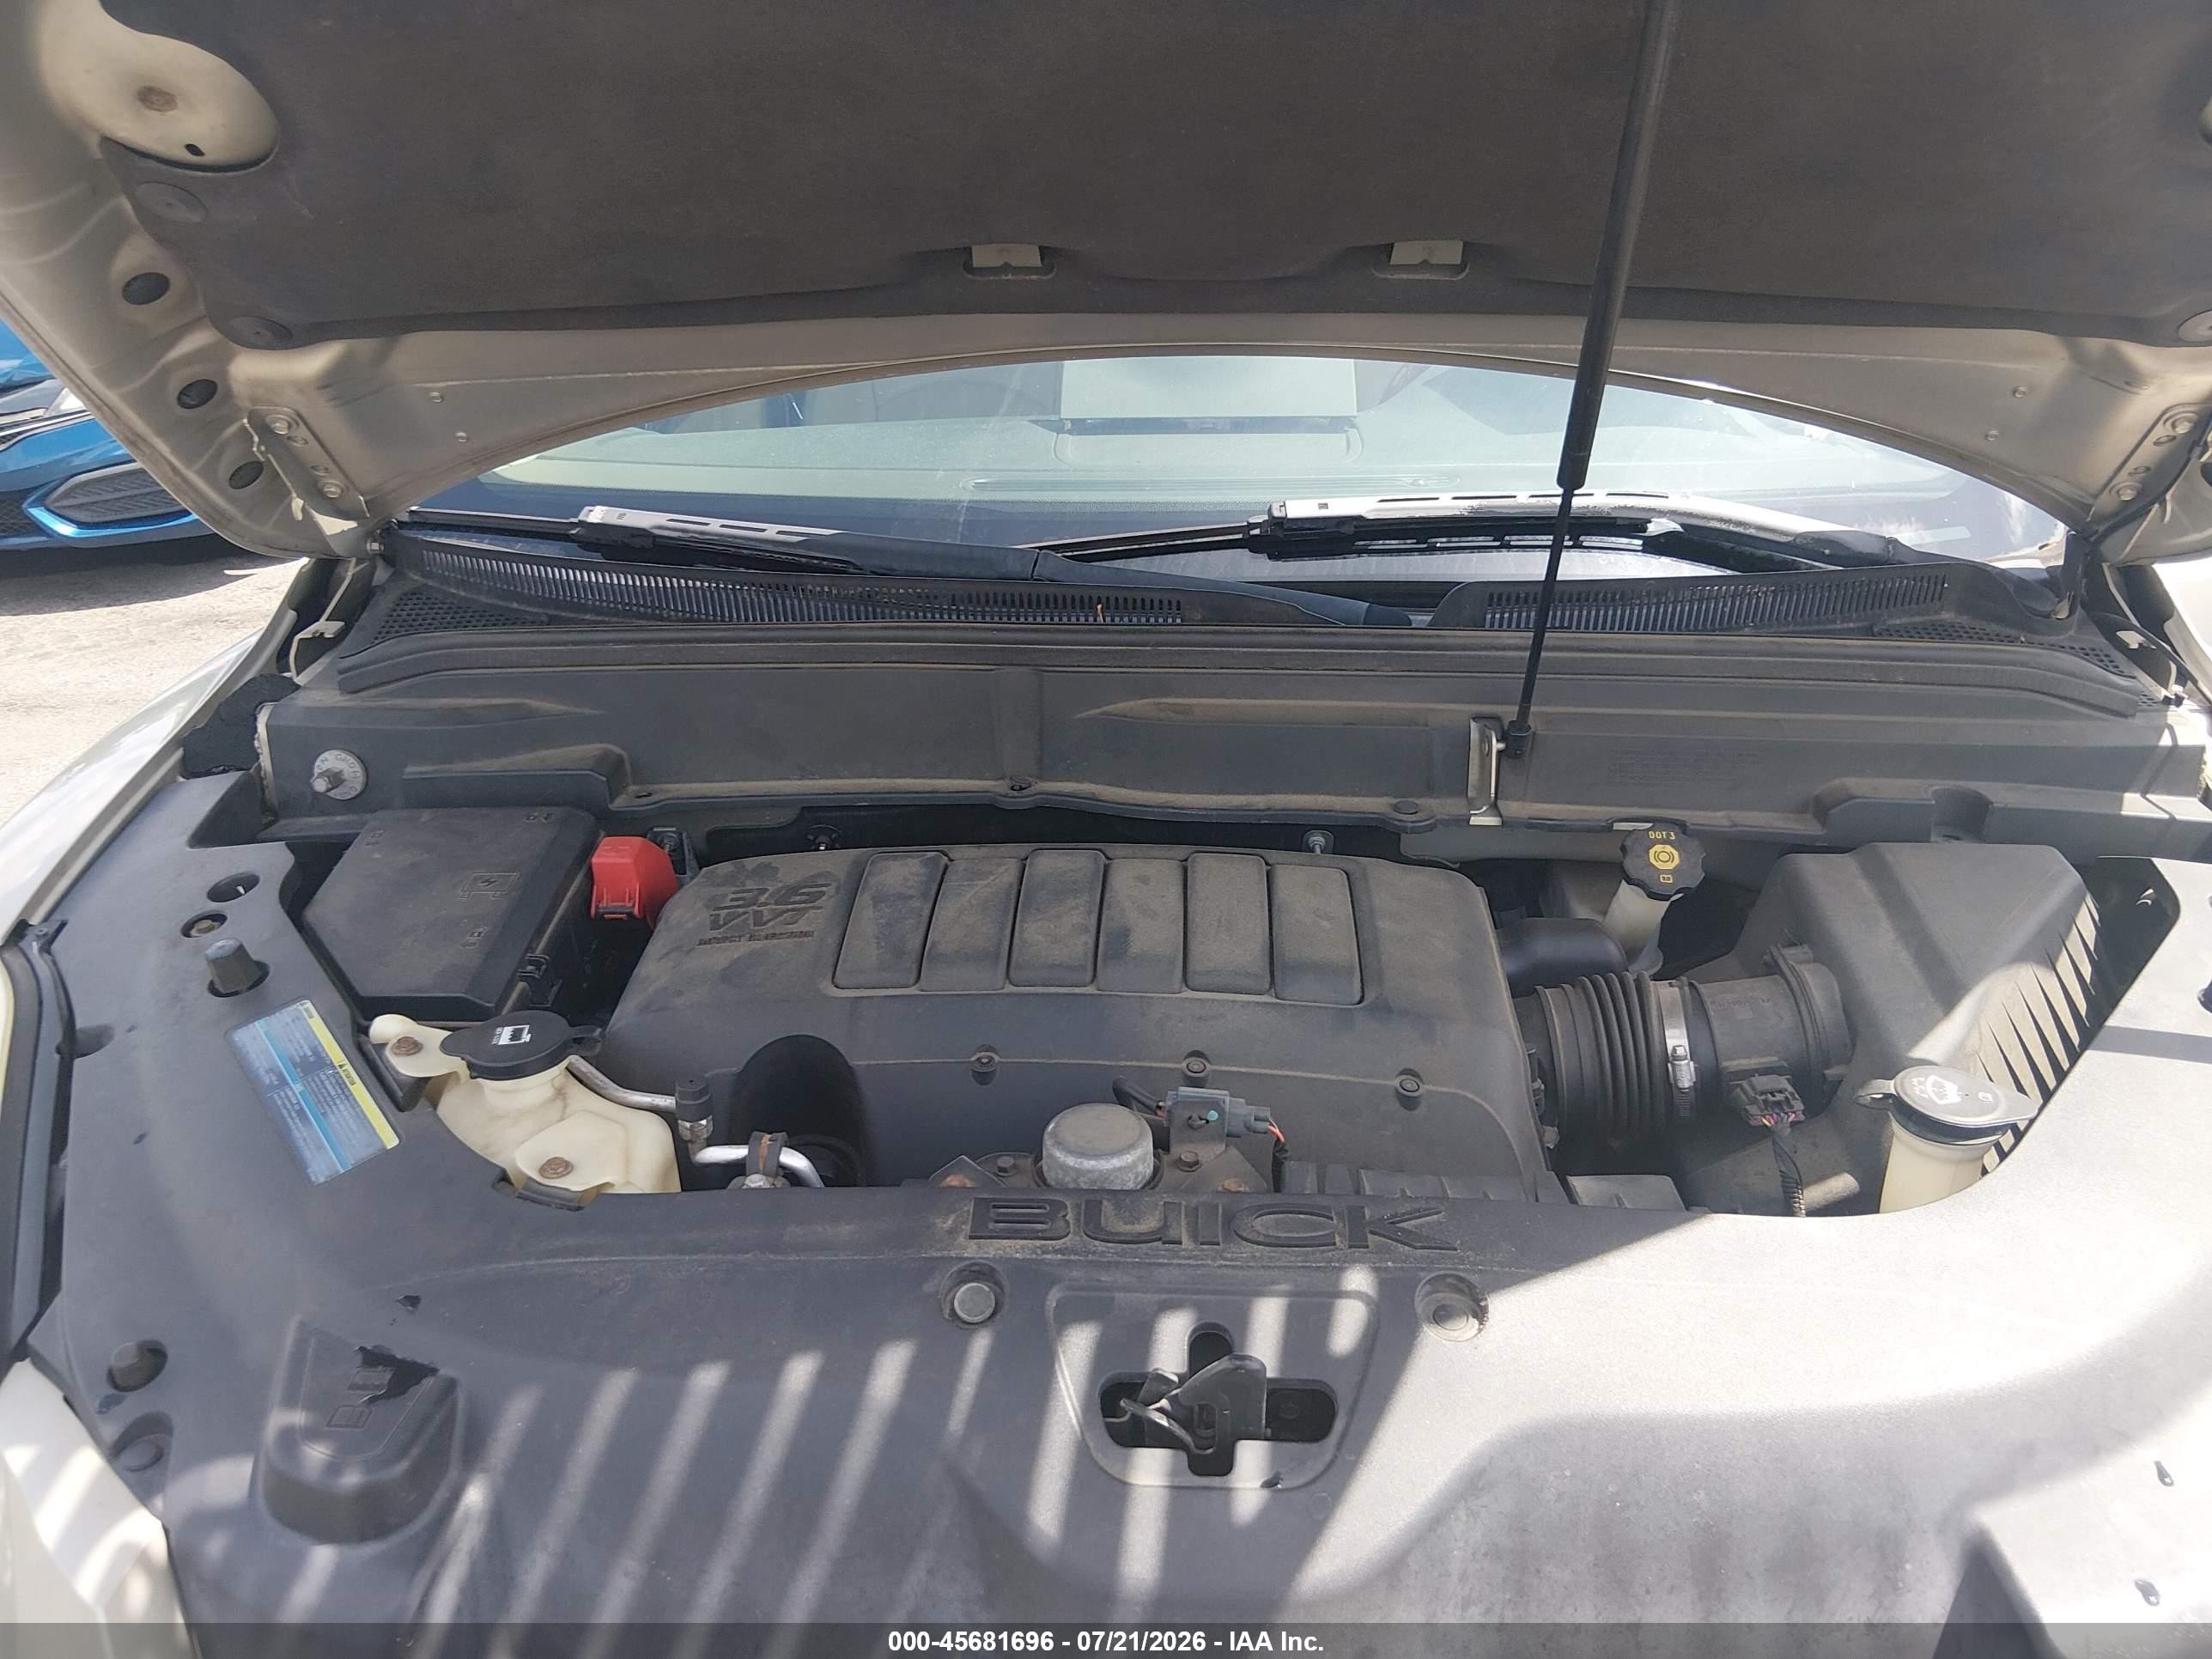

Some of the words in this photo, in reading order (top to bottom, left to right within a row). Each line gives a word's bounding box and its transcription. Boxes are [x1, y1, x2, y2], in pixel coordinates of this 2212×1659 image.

[1649, 830, 1667, 839] DOT
[1669, 831, 1675, 840] 3
[713, 883, 832, 911] 3.6
[709, 906, 823, 931] VVT
[968, 1197, 1458, 1252] BUICK
